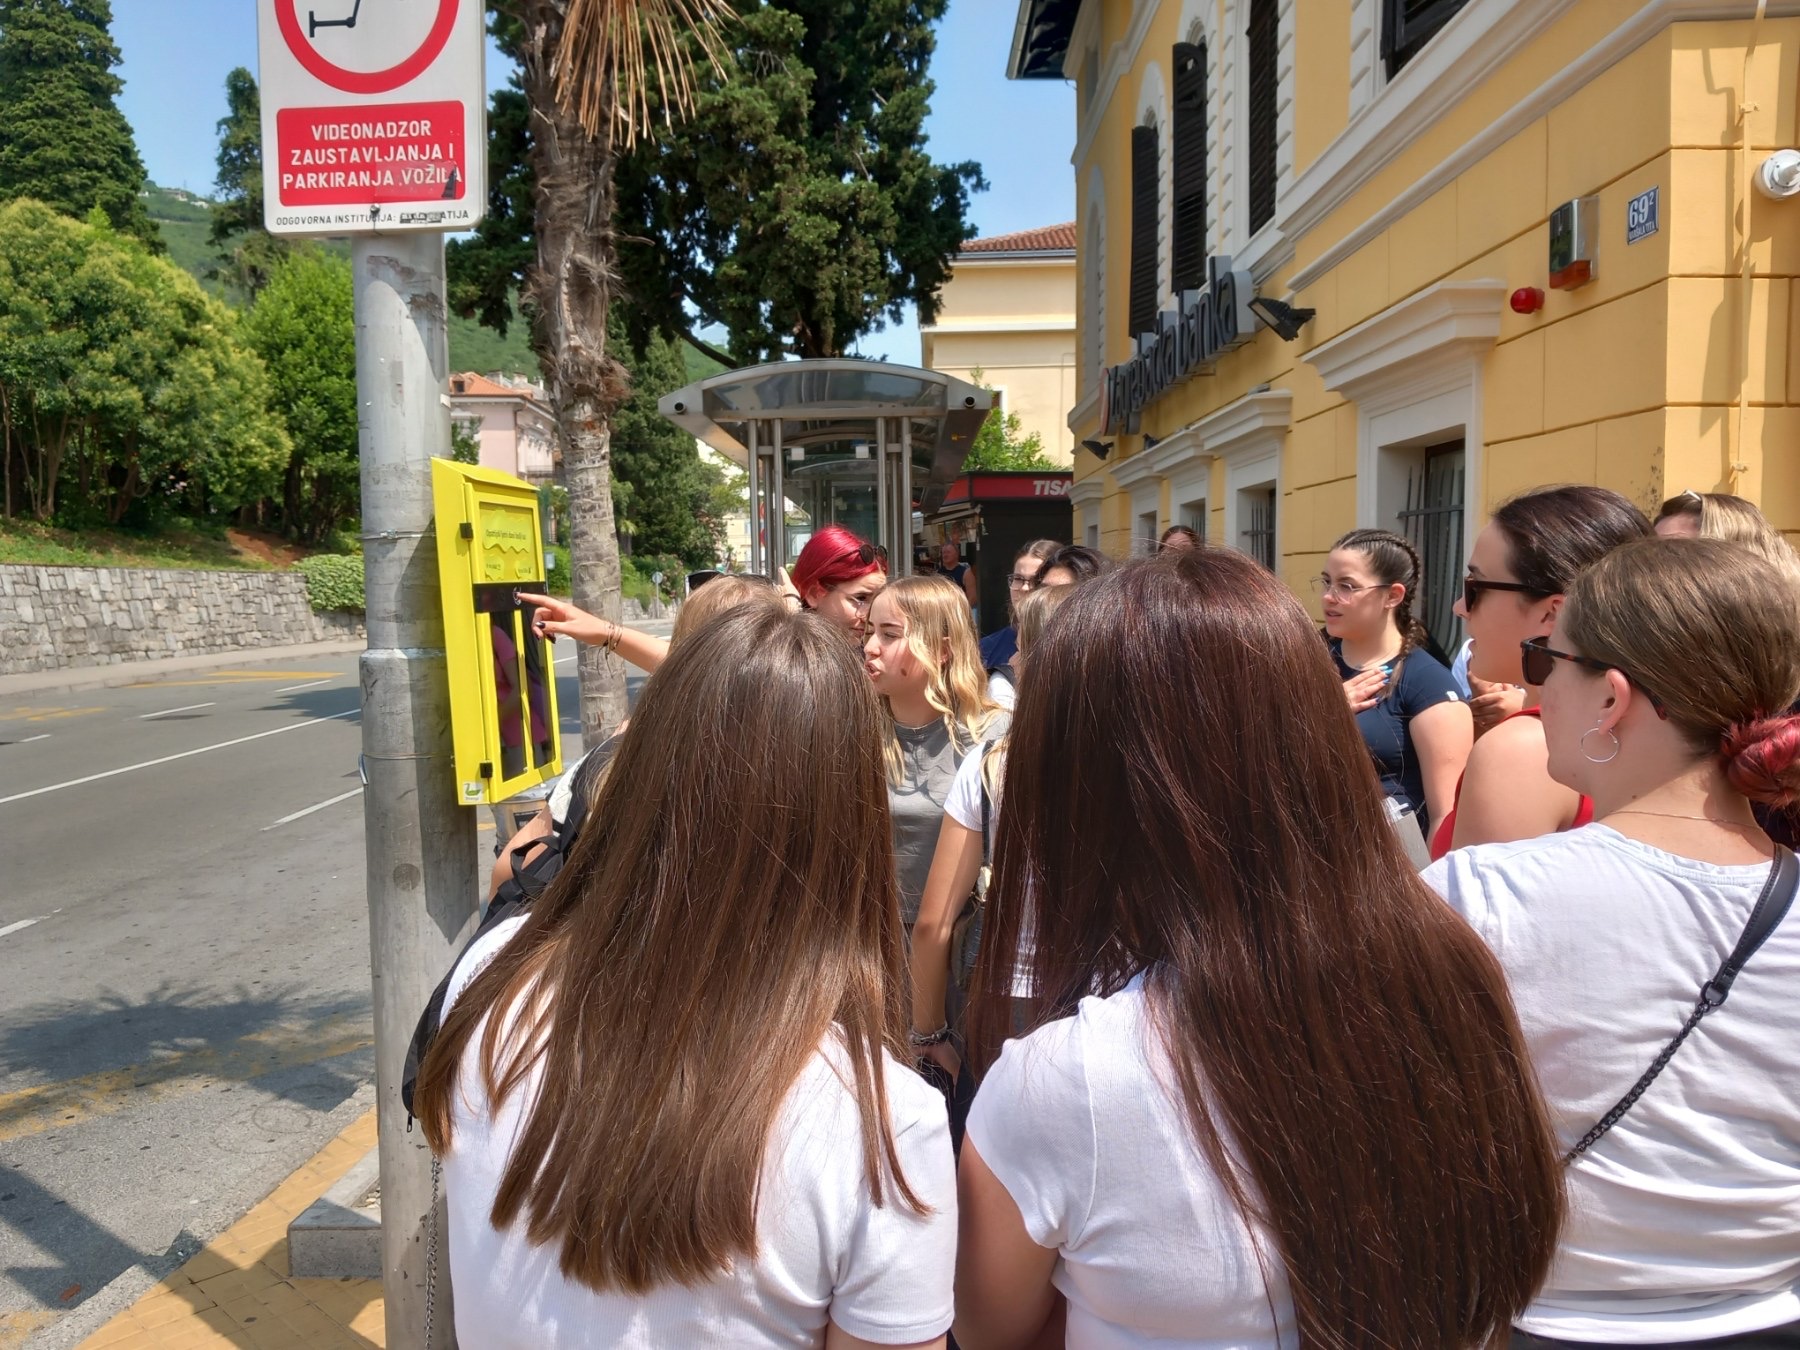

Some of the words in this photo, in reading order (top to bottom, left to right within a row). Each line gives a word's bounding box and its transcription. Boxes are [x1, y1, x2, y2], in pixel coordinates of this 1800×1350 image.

[311, 120, 432, 141] VIDEONADZOR
[291, 144, 443, 166] ZAUSTAVLJANJA
[448, 142, 454, 159] I
[283, 169, 394, 190] PARKIRANJA
[276, 213, 332, 226] ODGOVORNA
[1177, 255, 1247, 376] banka
[1032, 479, 1073, 496] TISA
